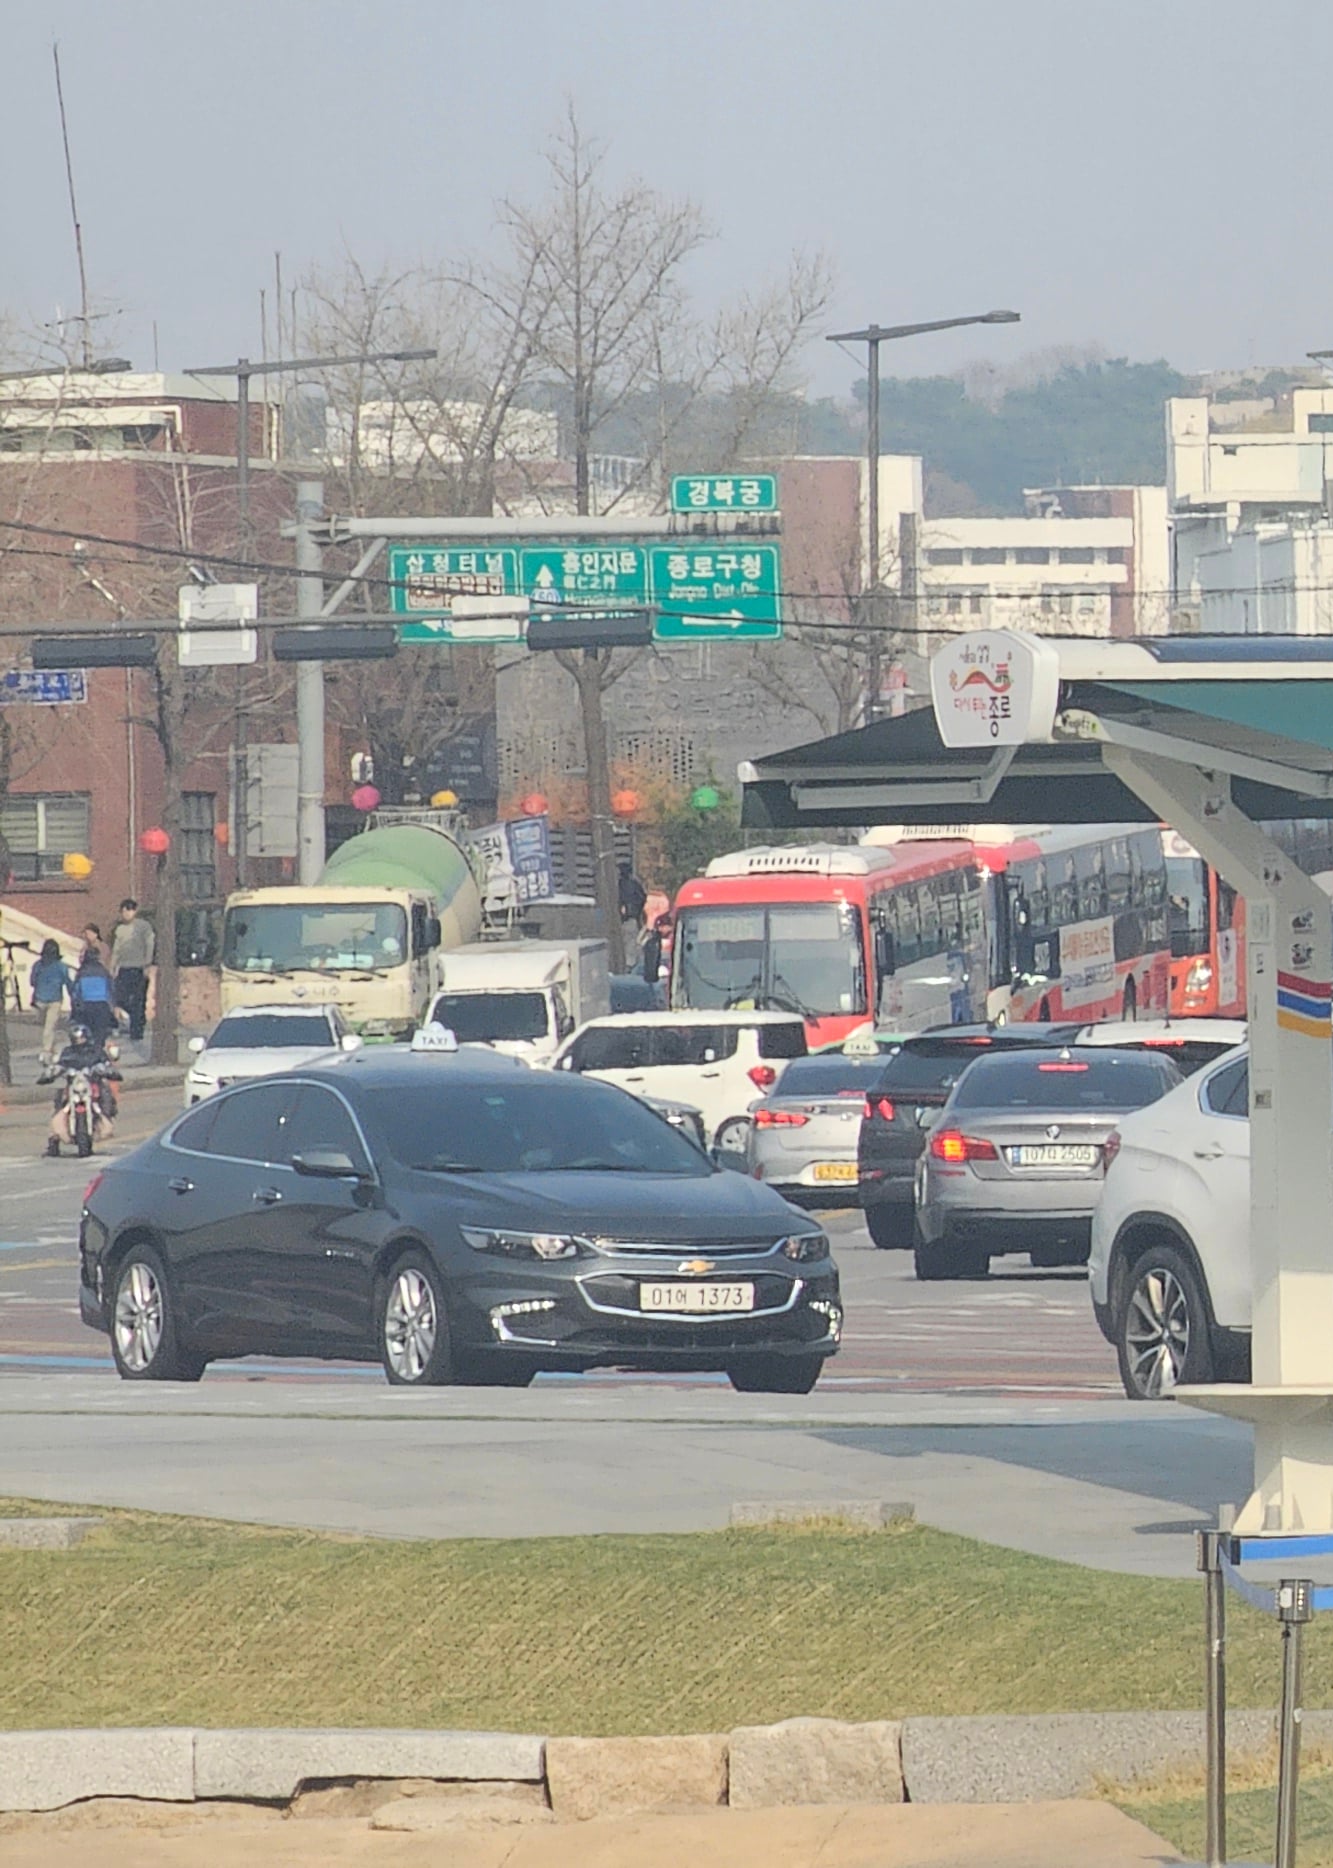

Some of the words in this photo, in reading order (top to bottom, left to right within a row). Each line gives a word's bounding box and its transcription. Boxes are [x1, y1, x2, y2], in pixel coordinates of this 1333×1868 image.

[688, 480, 762, 506] 경복궁
[407, 554, 503, 573] 삼청터널
[562, 551, 637, 574] 흥인지문
[668, 554, 761, 579] 종로구청
[422, 1036, 448, 1046] TAXI
[698, 1288, 743, 1306] 1373
